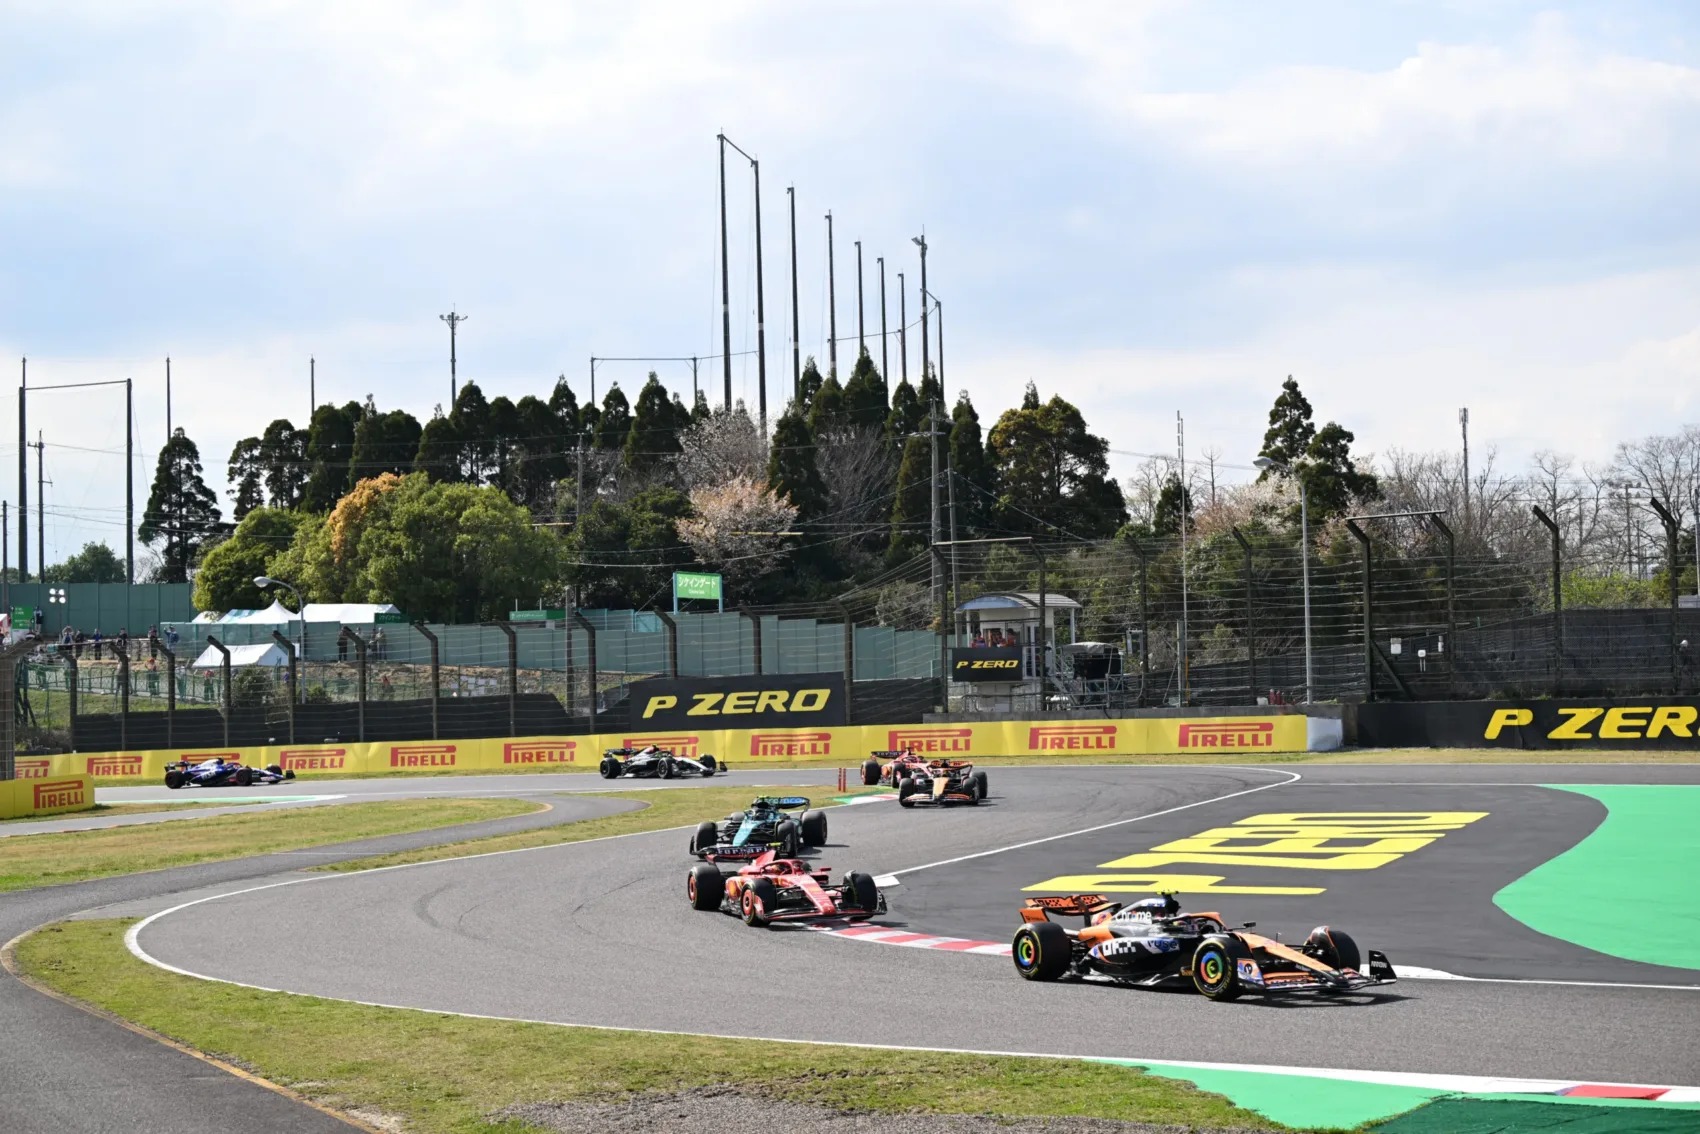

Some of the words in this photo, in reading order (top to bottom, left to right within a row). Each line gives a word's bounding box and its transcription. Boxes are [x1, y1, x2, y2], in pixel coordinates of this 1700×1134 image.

[956, 661, 969, 669] P
[971, 660, 1019, 669] ZERO
[642, 695, 678, 719] P
[686, 688, 831, 716] ZERO
[1484, 708, 1534, 740] P
[1547, 706, 1700, 740] ZER
[750, 732, 832, 757] PIRELLI
[887, 729, 972, 752] PIRELLI
[1028, 725, 1118, 750] PIRELLI
[1178, 722, 1275, 748] PIRELLI
[279, 749, 346, 770] PIRELLI
[390, 745, 457, 767] PIRELLI
[503, 741, 577, 764] PIRELLI
[623, 736, 699, 760] PLLI
[15, 760, 50, 779] ELLI
[87, 756, 143, 776] PIRELLI
[34, 780, 84, 809] PIRELLI
